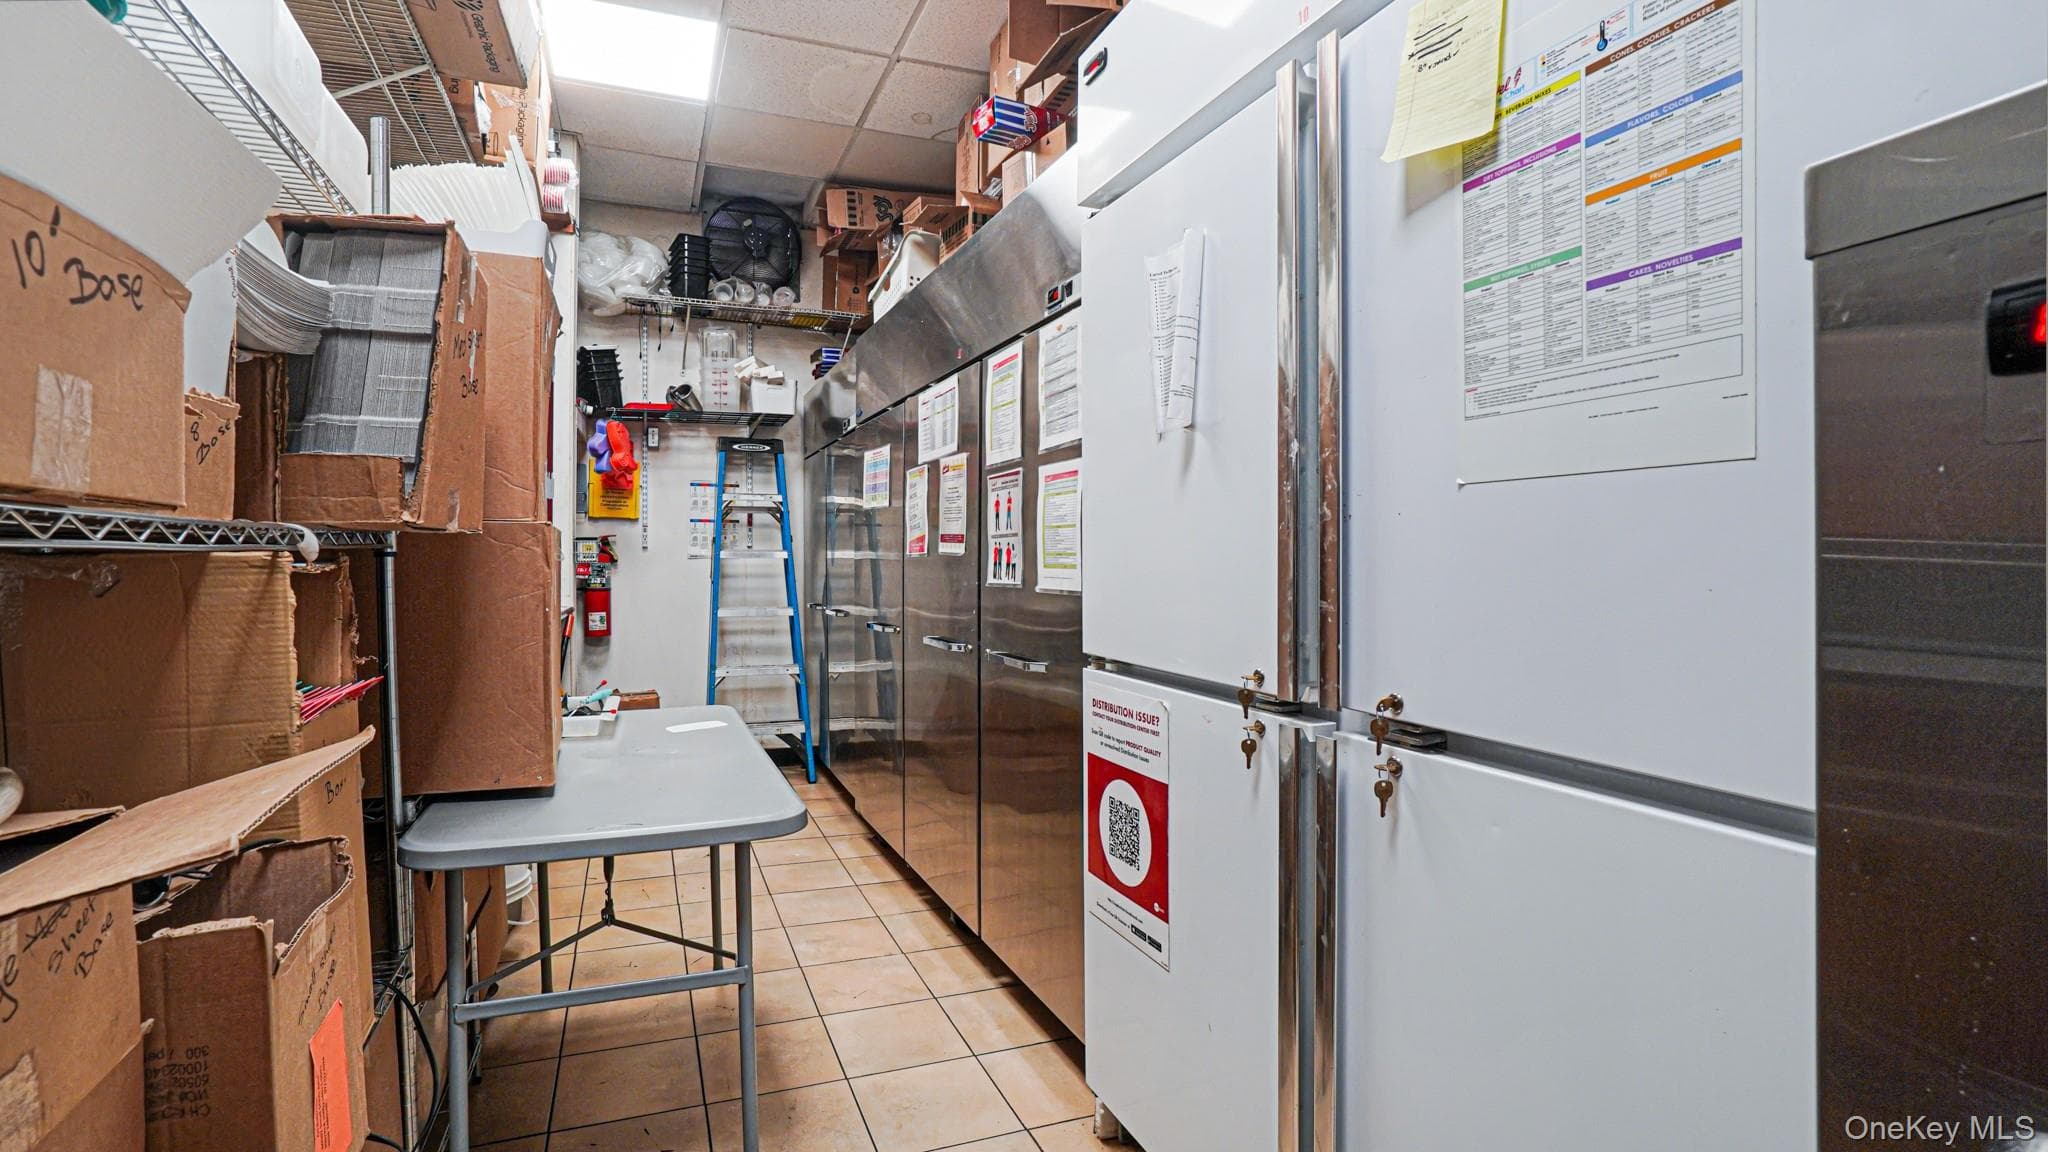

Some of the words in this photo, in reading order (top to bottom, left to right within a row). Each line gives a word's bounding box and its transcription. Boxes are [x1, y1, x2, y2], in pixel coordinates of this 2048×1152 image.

[1673, 4, 1716, 29] CRACKERS
[471, 13, 488, 39] Graphic
[482, 37, 501, 73] Packaging
[1535, 88, 1552, 100] MIXES
[1662, 95, 1695, 114] COLORS
[1649, 168, 1668, 181] FRUIT
[1655, 254, 1694, 271] NOVELTIES
[63, 257, 145, 312] Base
[1092, 698, 1134, 719] DISTRIBUTION
[1135, 711, 1160, 727] ISSUE?
[1105, 715, 1114, 723] YOUR
[1114, 719, 1137, 730] DISTRIBUTION
[1136, 725, 1150, 735] CENTER
[1125, 740, 1143, 752] PRODUCT
[1144, 746, 1162, 758] QUALITY
[186, 1045, 209, 1060] 300
